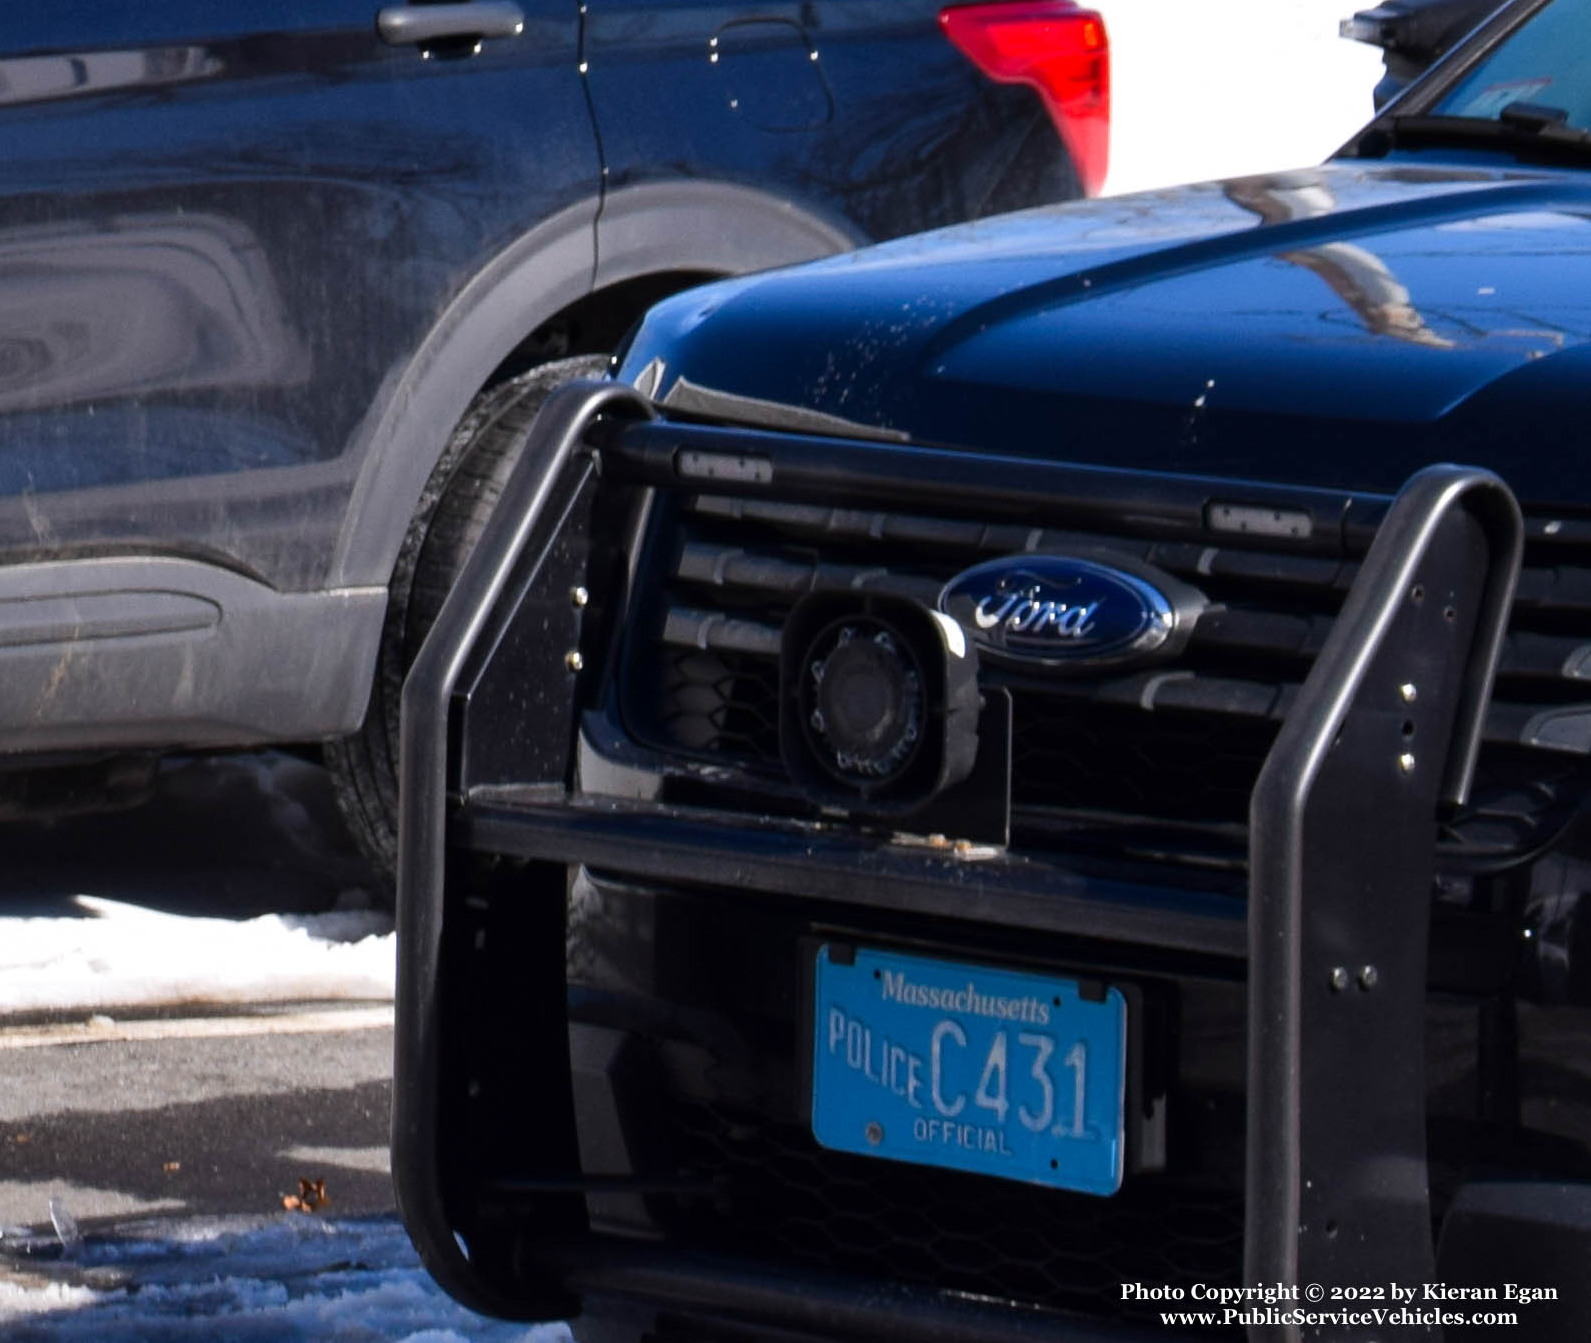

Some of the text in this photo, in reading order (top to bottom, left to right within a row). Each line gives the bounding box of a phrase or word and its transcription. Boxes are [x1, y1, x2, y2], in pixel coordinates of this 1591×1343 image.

[975, 569, 1105, 638] Ford
[882, 969, 1050, 1025] Massachusetts
[827, 1006, 1087, 1139] POLICE C431
[913, 1116, 1012, 1156] OFFICIAL
